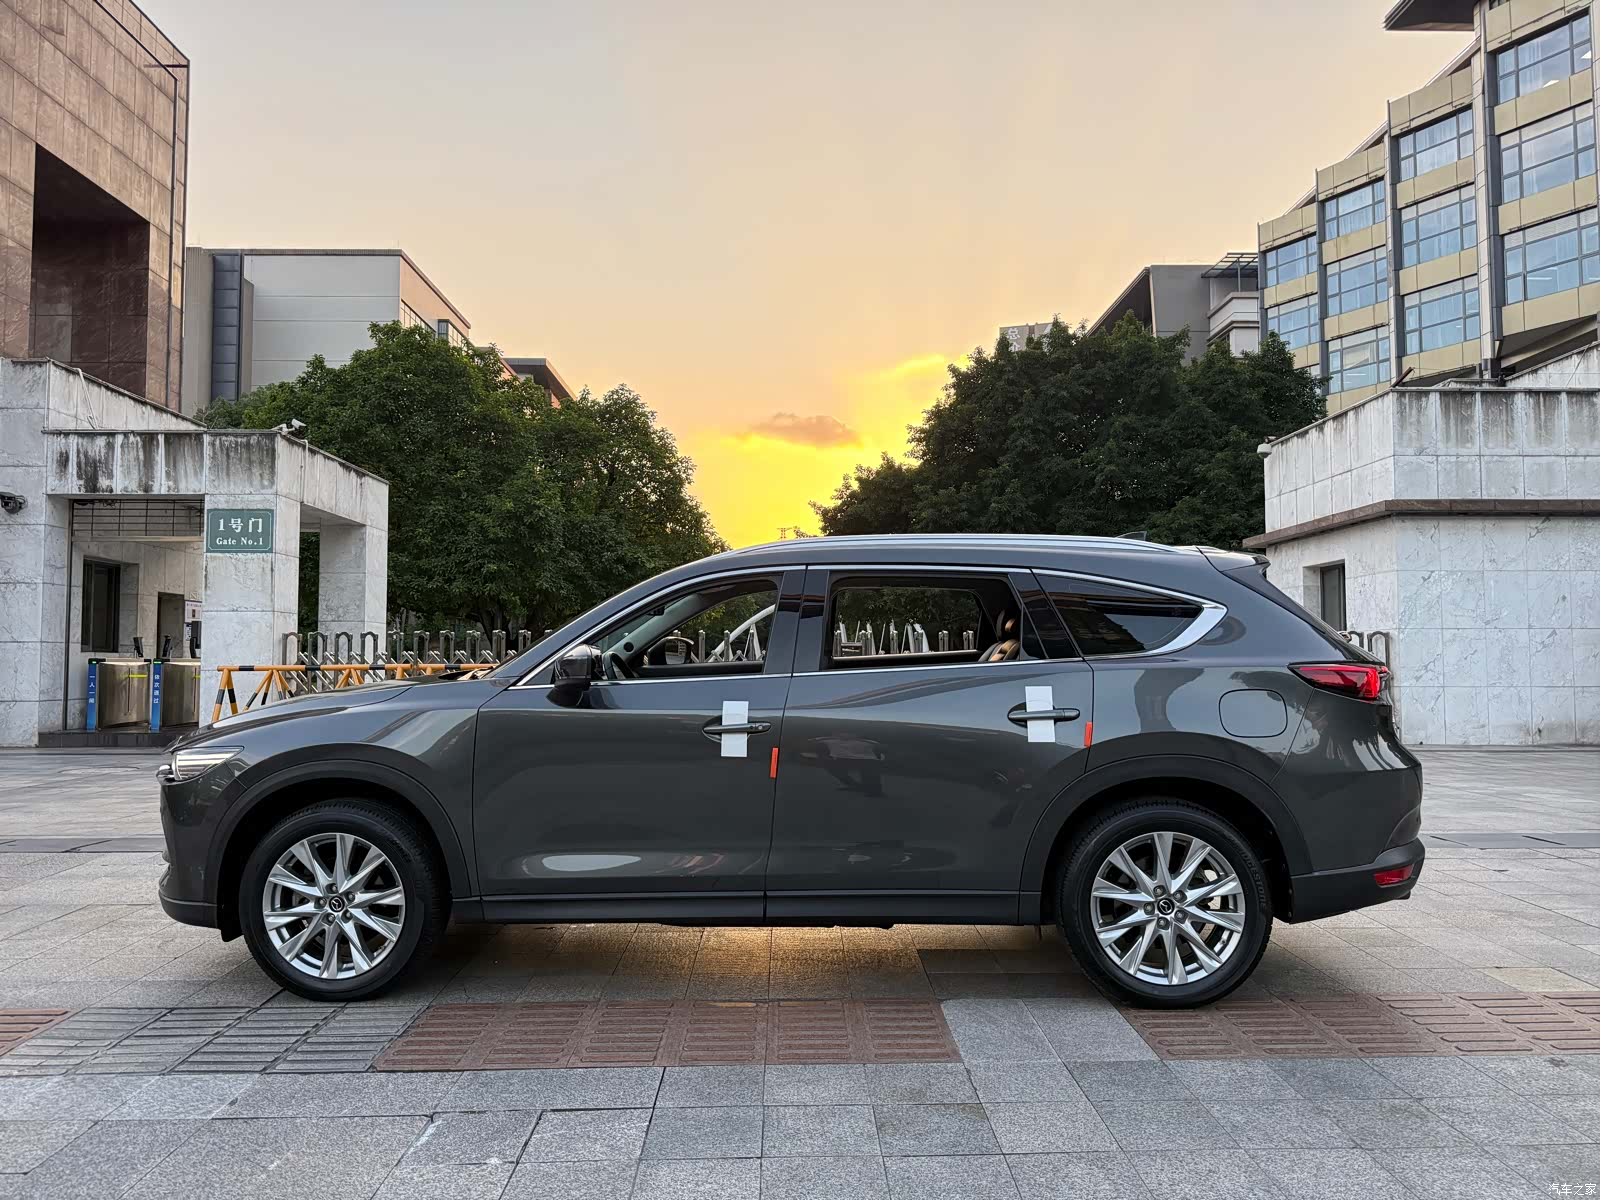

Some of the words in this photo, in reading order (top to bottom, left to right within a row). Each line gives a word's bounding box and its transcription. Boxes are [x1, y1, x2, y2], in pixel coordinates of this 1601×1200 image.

[218, 517, 263, 533] 1号门
[216, 537, 237, 546] Gate
[240, 536, 263, 546] No.1
